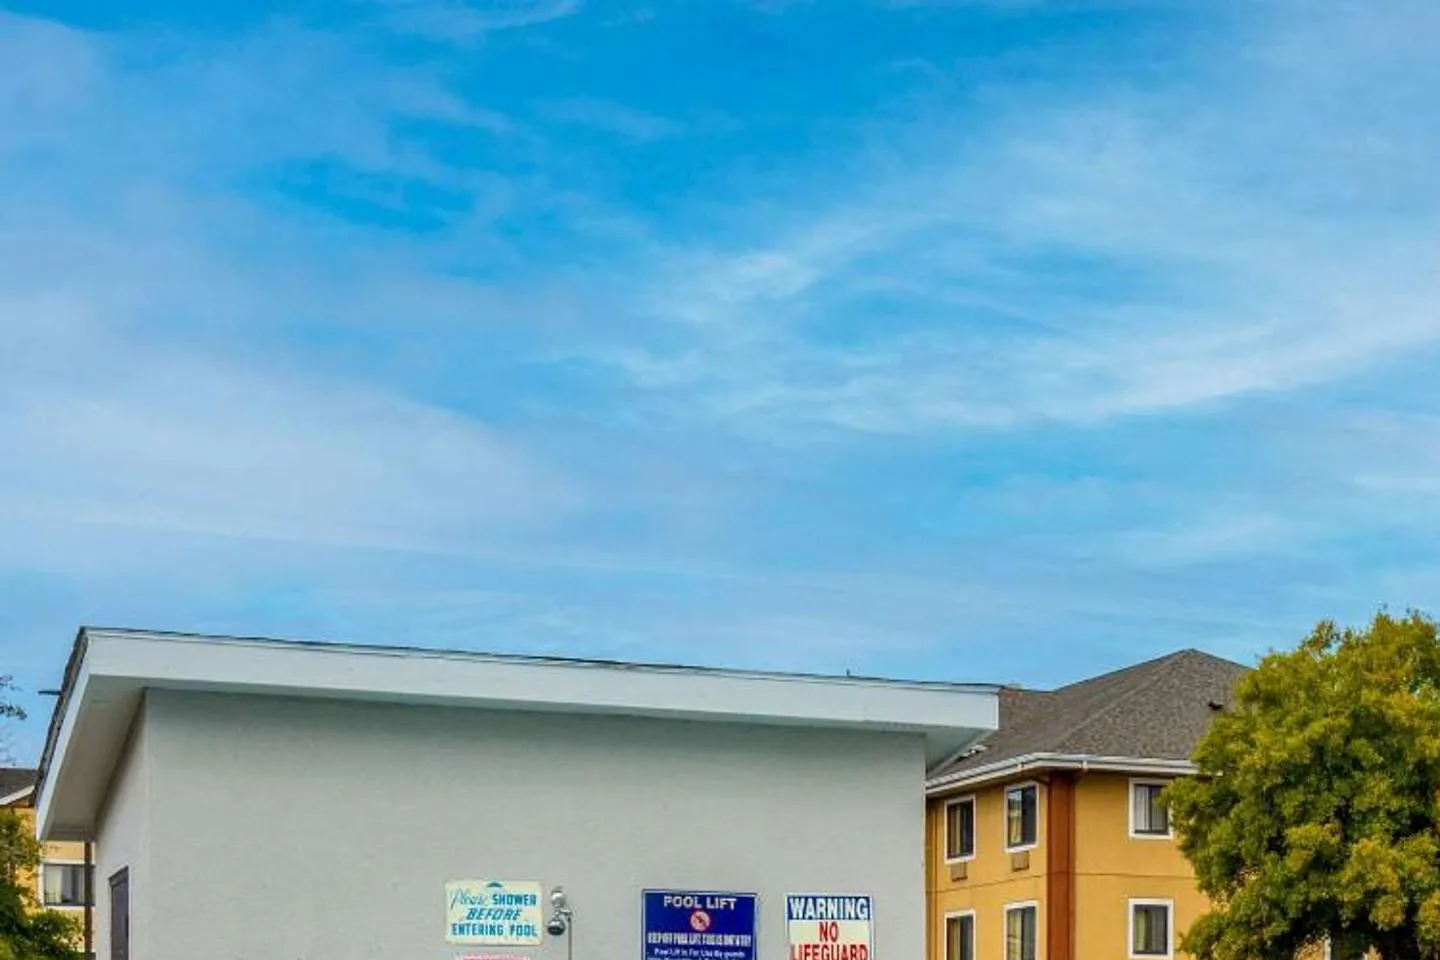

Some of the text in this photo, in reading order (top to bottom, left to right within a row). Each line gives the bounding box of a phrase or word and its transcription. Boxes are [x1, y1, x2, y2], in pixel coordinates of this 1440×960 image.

[492, 894, 537, 906] SHOWER
[663, 895, 737, 910] POOL LIFT
[466, 907, 522, 920] BEFORE
[789, 897, 869, 920] WARNING
[451, 923, 538, 937] ENTERING POOL
[819, 921, 840, 942] NO
